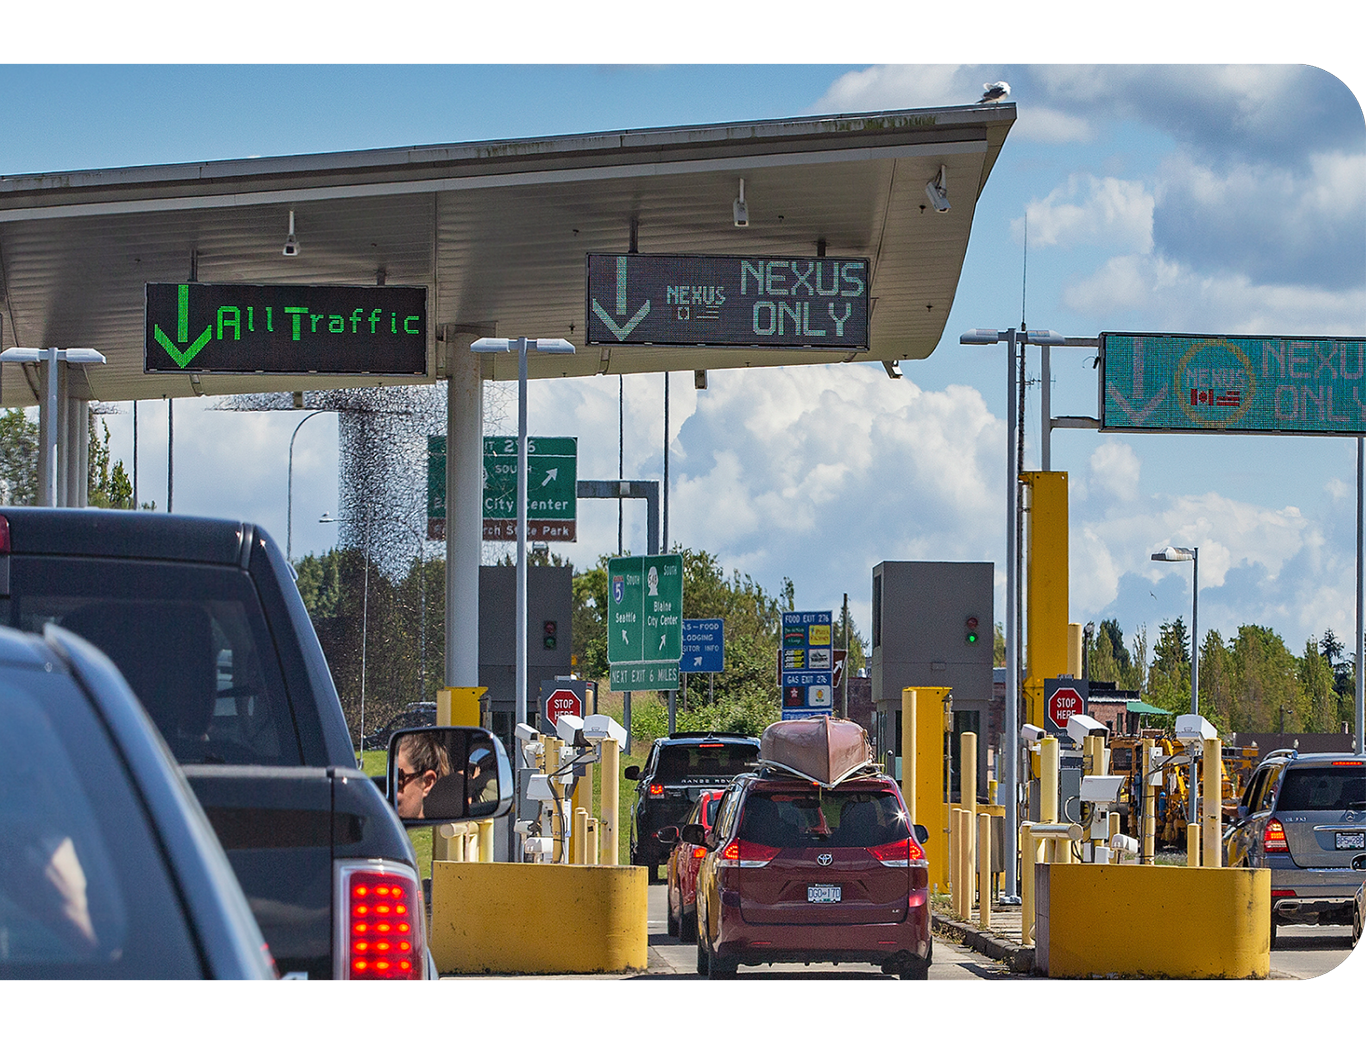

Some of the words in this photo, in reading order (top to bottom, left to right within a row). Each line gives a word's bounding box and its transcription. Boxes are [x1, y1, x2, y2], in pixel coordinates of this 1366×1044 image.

[741, 260, 865, 297] NEXUS
[666, 285, 726, 305] NEXUS
[216, 305, 274, 340] All
[284, 306, 420, 341] Traffic
[752, 301, 852, 337] ONLY
[1262, 341, 1365, 379] NEXU
[504, 439, 536, 453] 26
[495, 464, 533, 474] SOUH
[485, 498, 514, 512] City
[484, 525, 501, 536] rch
[506, 526, 537, 536] Ste
[542, 525, 570, 537] Park
[615, 583, 622, 601] 5
[653, 601, 672, 612] Blaine
[615, 612, 636, 623] Seattle
[647, 615, 658, 628] City
[660, 615, 678, 625] Center
[785, 614, 801, 624] FOOD
[803, 614, 816, 623] EXIT
[682, 644, 701, 652] SITOR
[704, 644, 720, 652] INFO
[611, 670, 628, 683] NEXT
[631, 669, 646, 682] EXIT
[649, 669, 654, 682] 6
[657, 668, 677, 681] MILES
[787, 675, 800, 684] GAS
[801, 675, 814, 684] EXIT
[554, 698, 574, 709] STOP
[1056, 697, 1077, 708] STOP
